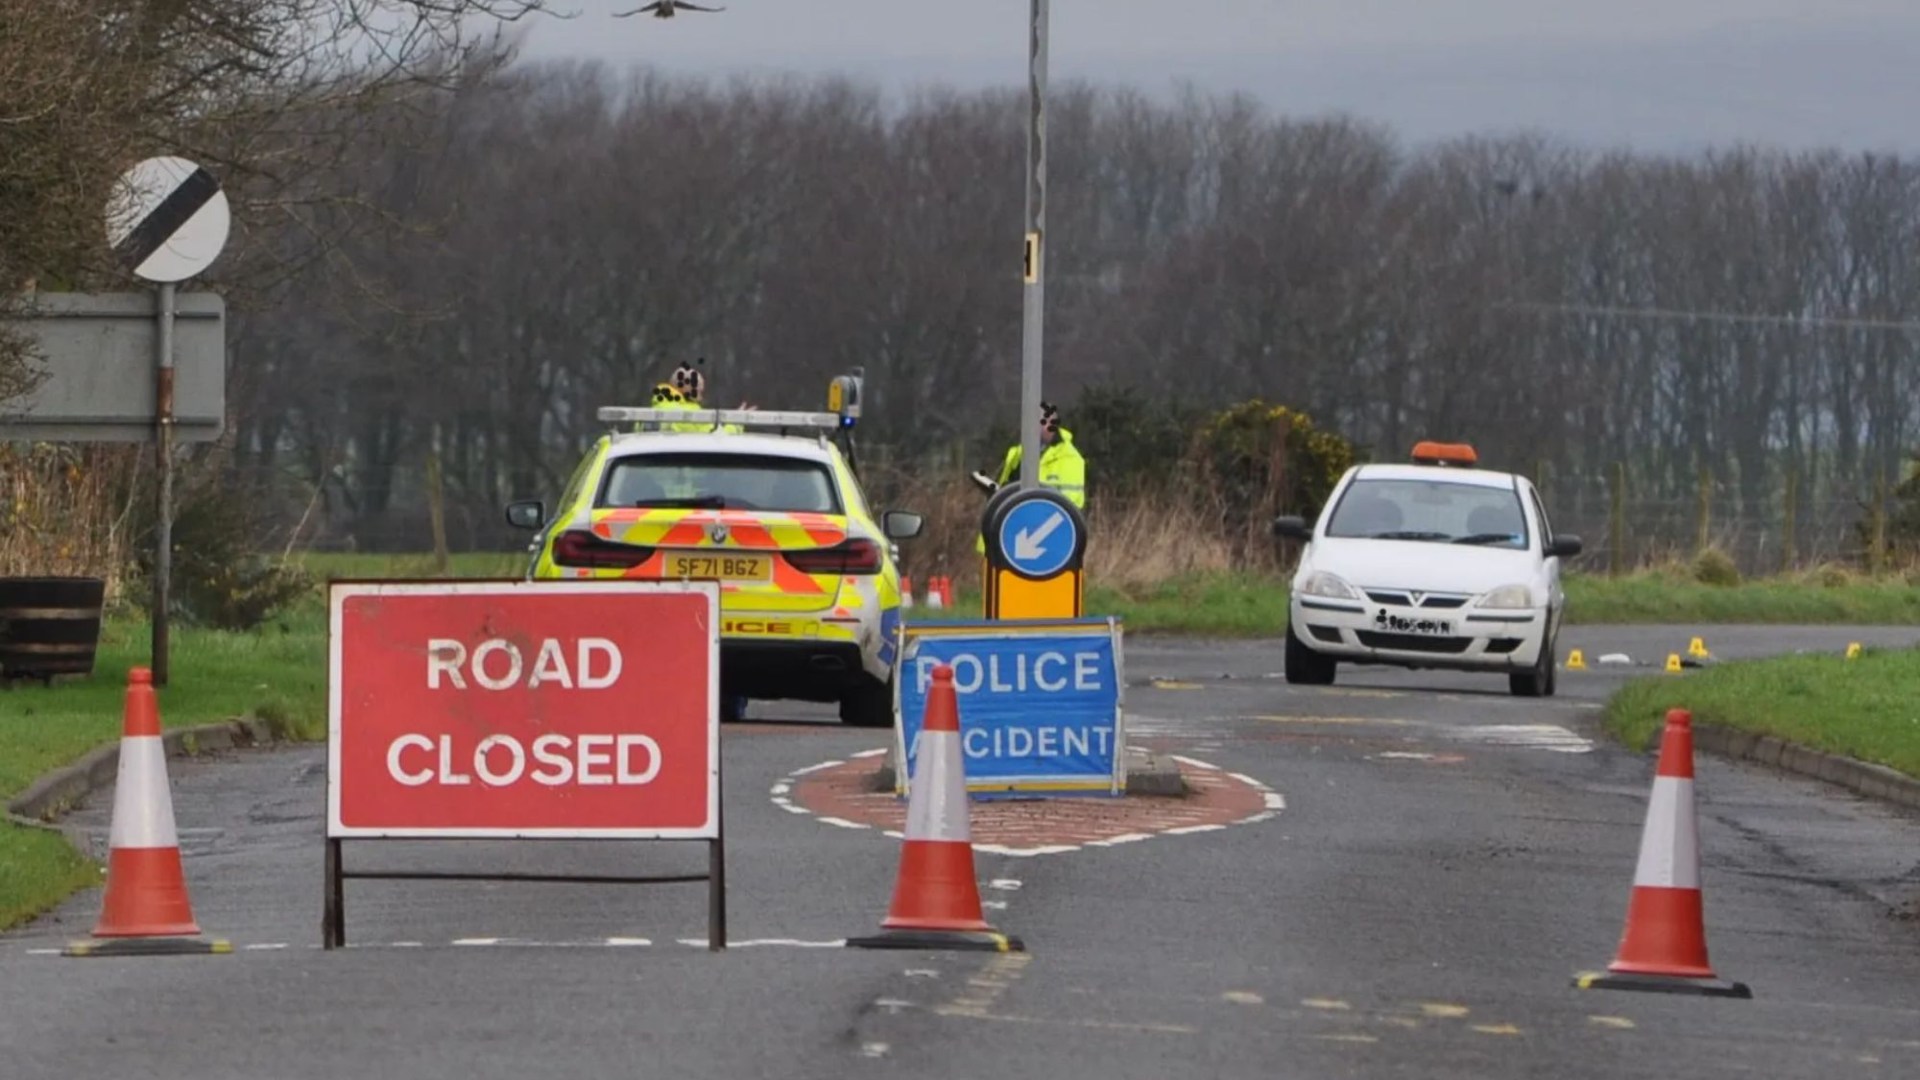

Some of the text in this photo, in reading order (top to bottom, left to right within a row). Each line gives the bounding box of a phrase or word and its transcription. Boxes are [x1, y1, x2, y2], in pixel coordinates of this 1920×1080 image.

[677, 558, 759, 576] SF71 BGZ
[725, 622, 791, 634] ICE
[427, 637, 623, 691] ROAD
[916, 651, 1101, 694] POLICE
[386, 733, 662, 787] CLOSED
[908, 726, 1113, 758] CIDENT
